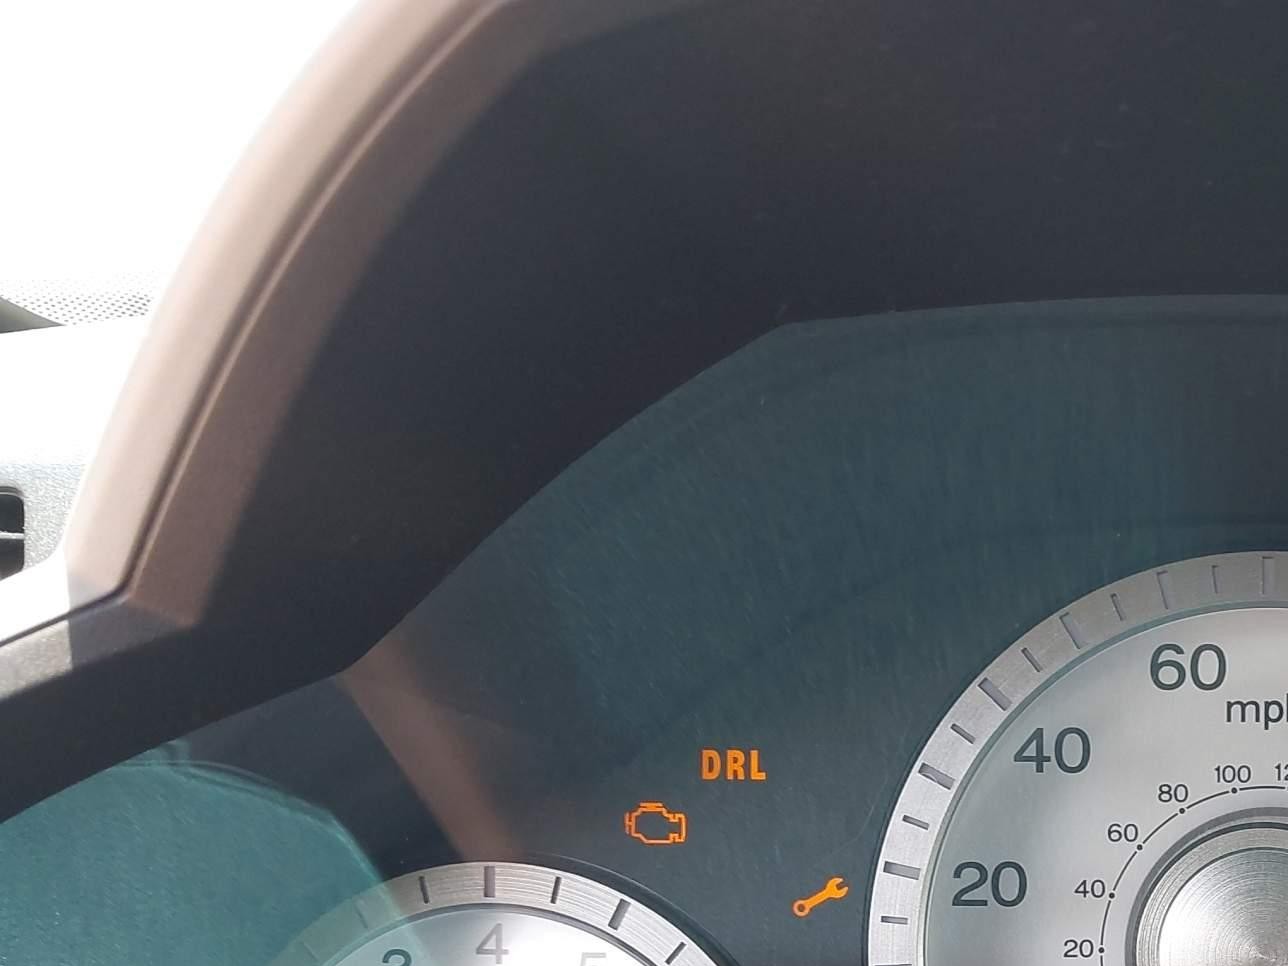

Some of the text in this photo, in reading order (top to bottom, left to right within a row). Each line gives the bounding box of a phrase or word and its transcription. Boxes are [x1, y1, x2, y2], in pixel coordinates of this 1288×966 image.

[1150, 643, 1226, 690] 60
[1013, 727, 1090, 773] 40
[701, 749, 768, 781] DRL
[1214, 765, 1251, 784] 100
[1158, 784, 1189, 803] 80
[1107, 823, 1138, 842] 60
[952, 862, 1027, 907] 20
[1074, 880, 1105, 898] 40
[475, 923, 509, 964] 4
[1063, 940, 1094, 958] 20
